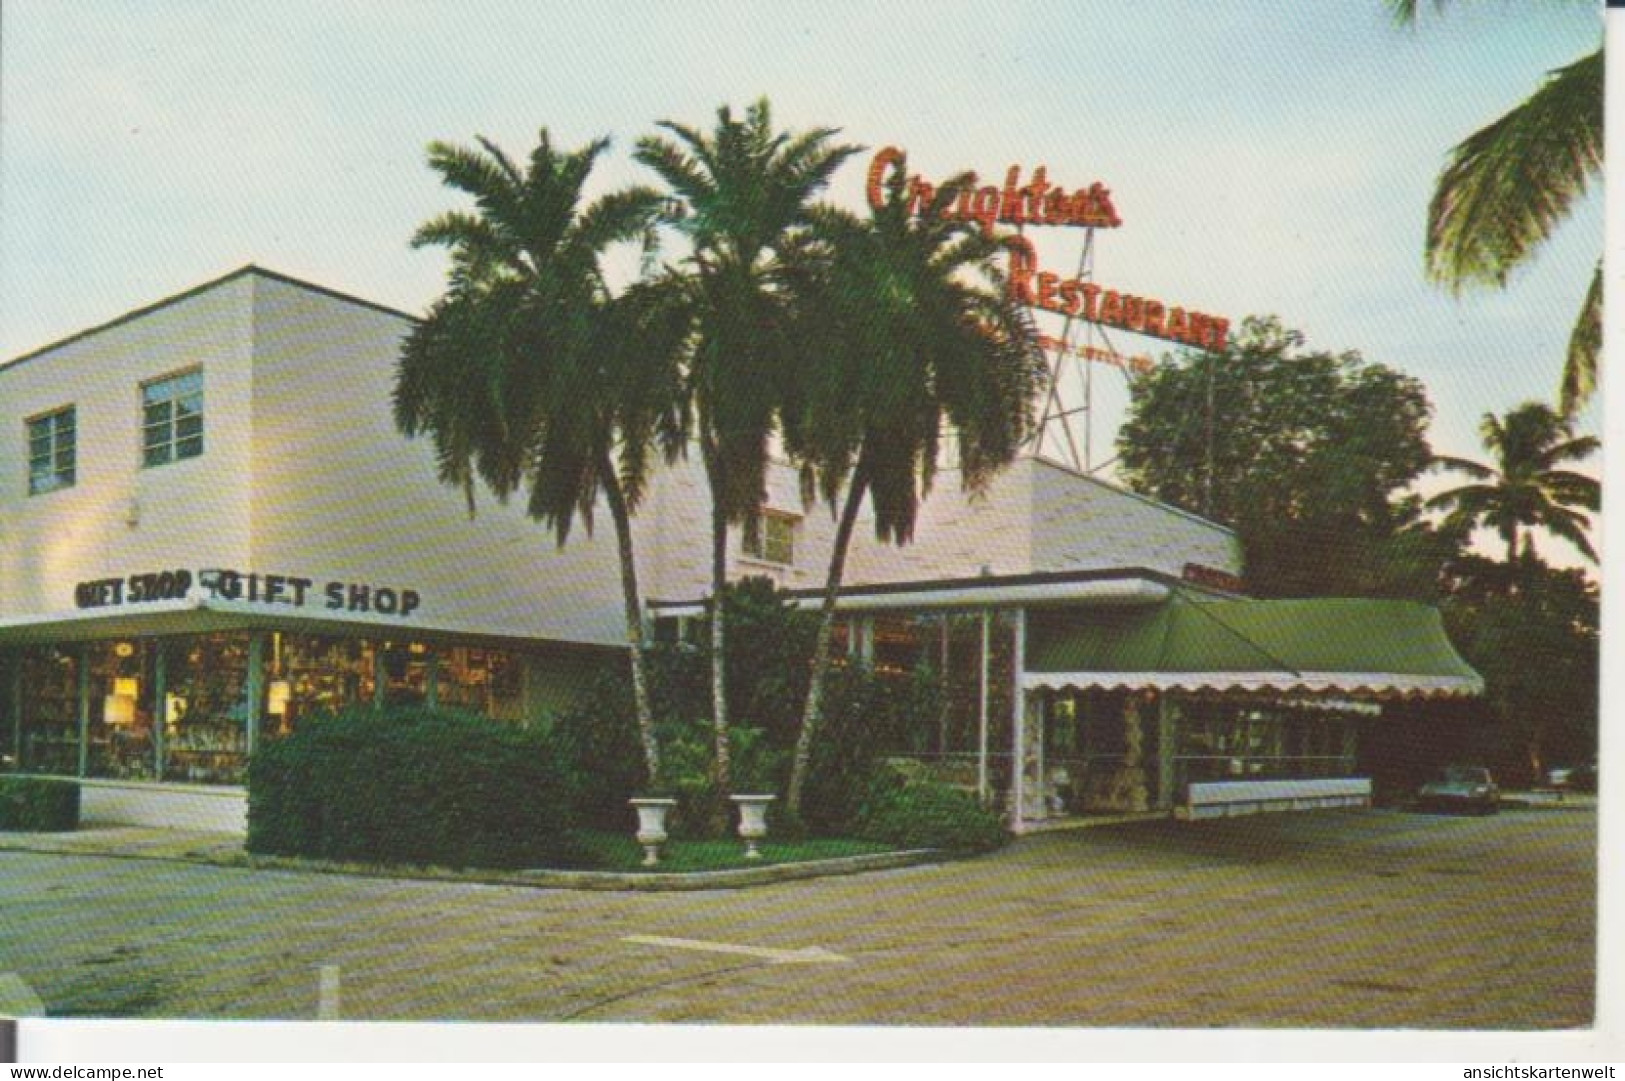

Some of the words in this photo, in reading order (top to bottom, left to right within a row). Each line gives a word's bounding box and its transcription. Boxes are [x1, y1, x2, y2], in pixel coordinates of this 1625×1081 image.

[866, 146, 1122, 239] Crighton's
[1001, 233, 1230, 352] RESTAURANT
[219, 569, 312, 606] GIFT
[325, 581, 420, 616] SHOP
